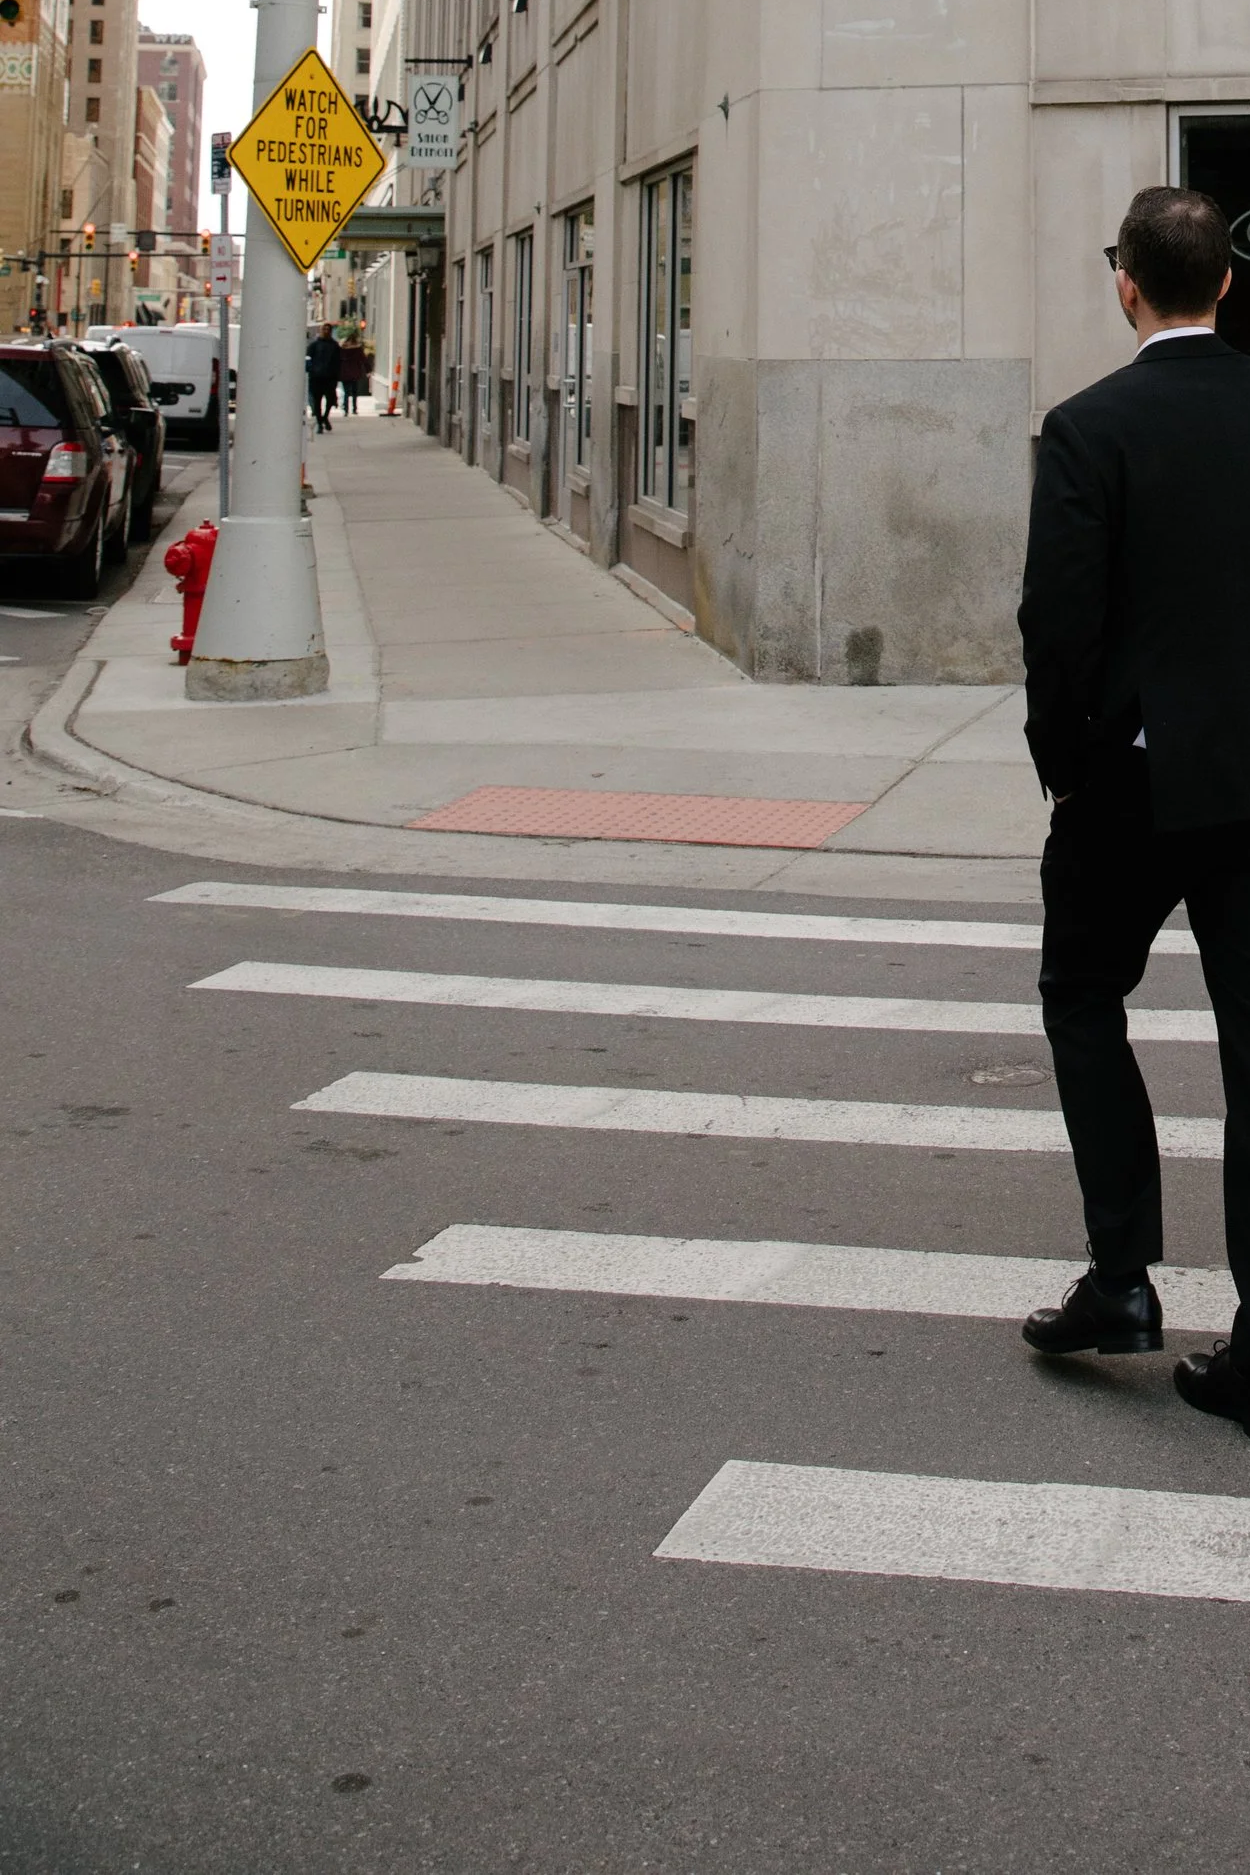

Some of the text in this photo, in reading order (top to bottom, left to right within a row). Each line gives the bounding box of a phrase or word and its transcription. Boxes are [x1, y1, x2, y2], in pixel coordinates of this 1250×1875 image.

[285, 88, 338, 115] WATCH
[295, 116, 328, 140] FOR
[257, 140, 363, 167] PEDESTRIANS
[285, 168, 335, 193] WHILE
[275, 198, 341, 223] TURNING
